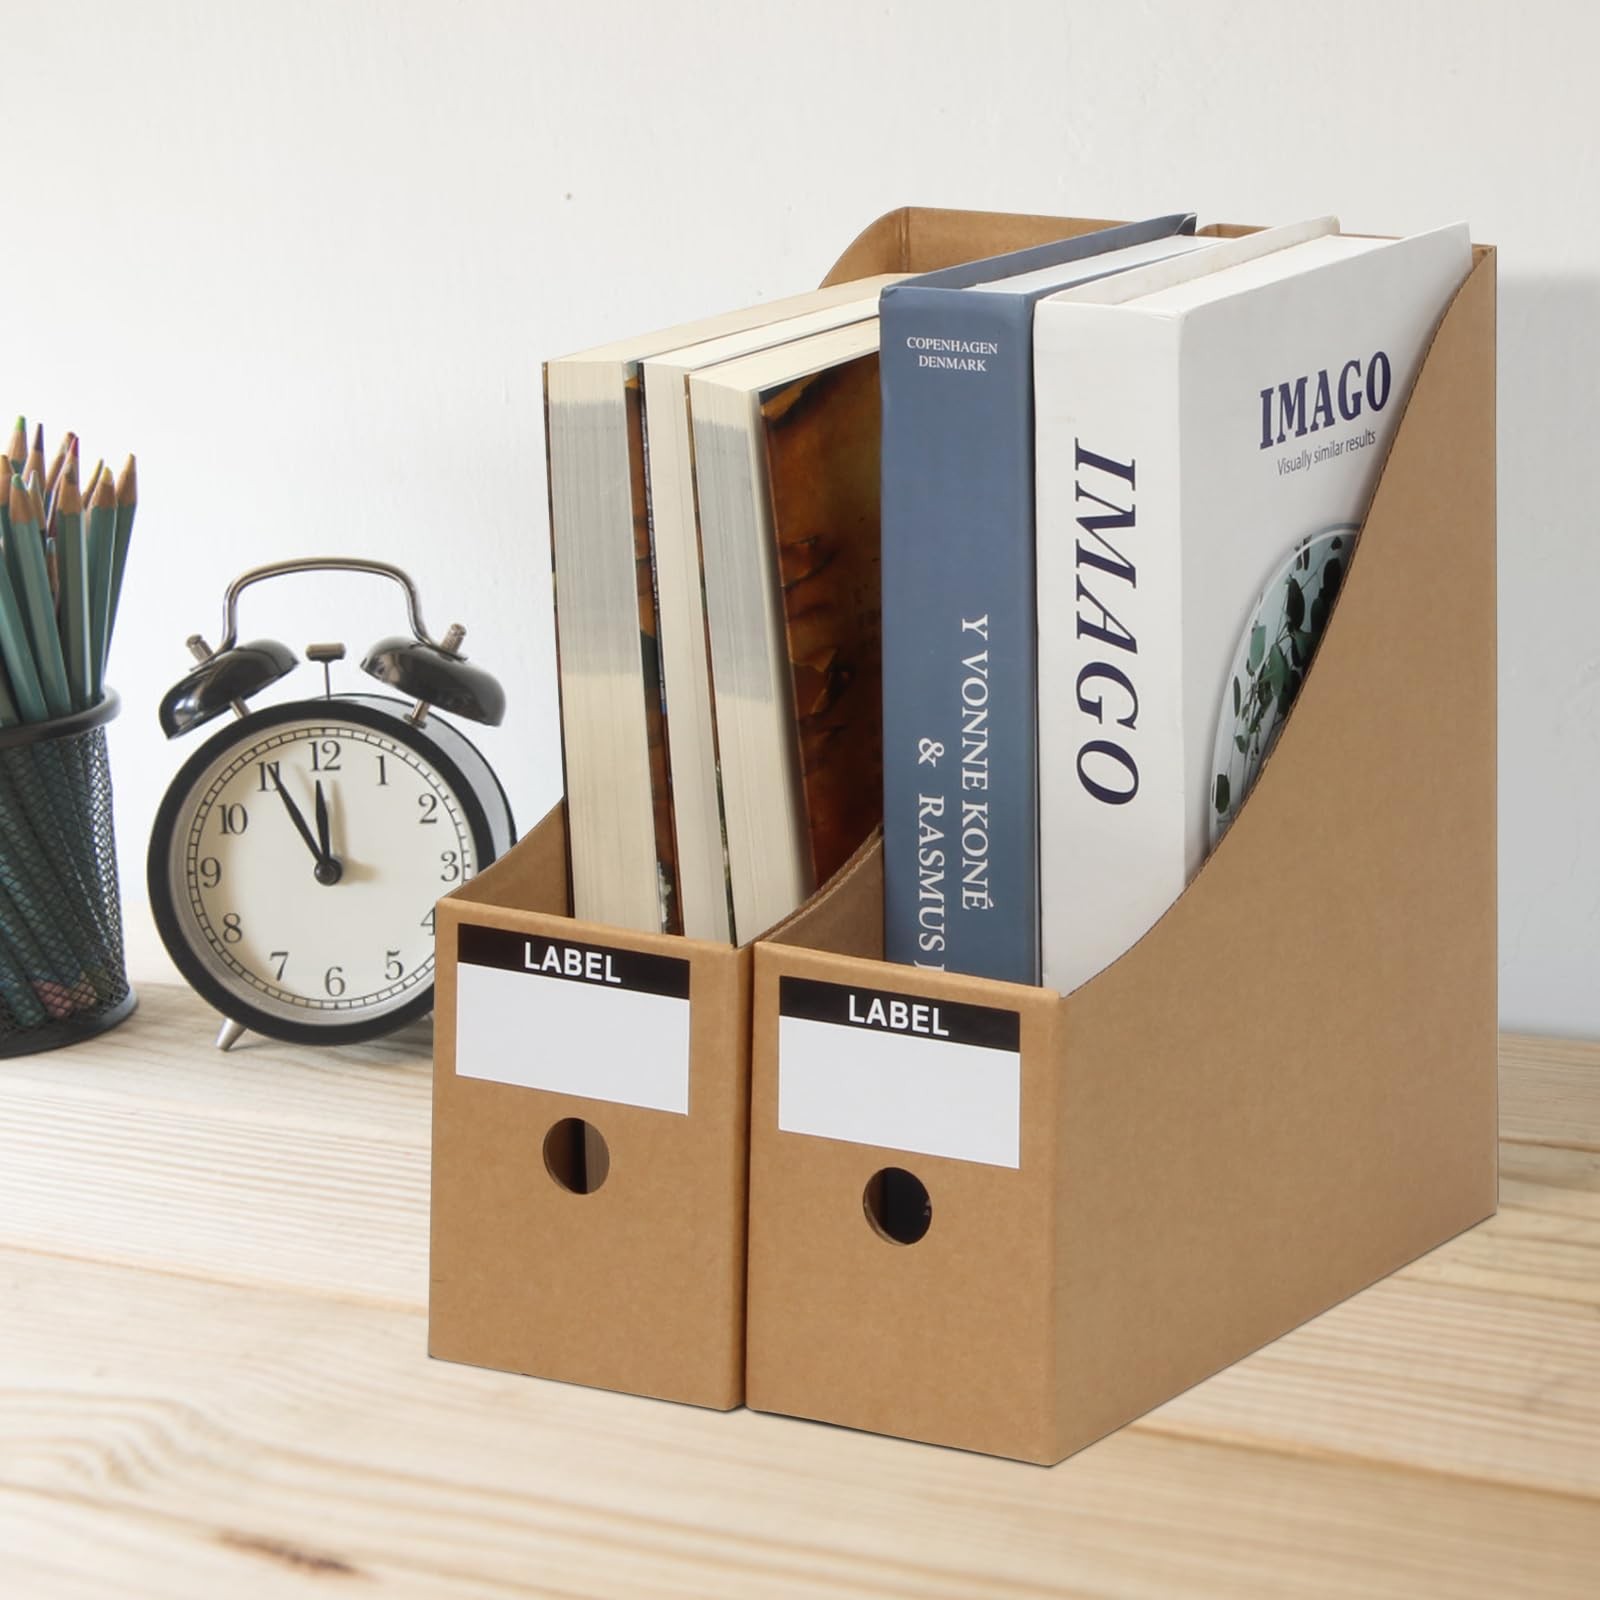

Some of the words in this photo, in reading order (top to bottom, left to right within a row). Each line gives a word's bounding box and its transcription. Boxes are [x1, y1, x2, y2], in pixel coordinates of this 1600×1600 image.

[906, 336, 998, 355] COPENHAGEN
[918, 355, 987, 372] DENMARK
[1260, 350, 1392, 450] IMAGO
[1277, 449, 1312, 476] Visually
[1313, 440, 1344, 464] similar
[1345, 428, 1377, 453] results
[1074, 437, 1140, 806] IMAGO
[309, 740, 342, 772] 12
[918, 736, 946, 768] &
[376, 755, 390, 786] 1
[218, 803, 249, 835] 10
[418, 793, 438, 825] 2
[440, 851, 460, 883] 3
[961, 799, 995, 911] KONÉ
[201, 857, 222, 888] 9
[918, 792, 946, 952] RASMUS
[223, 913, 242, 944] 8
[268, 951, 289, 981] 7
[384, 950, 405, 981] 5
[524, 941, 622, 984] LABEL
[324, 966, 346, 998] 6
[848, 994, 950, 1037] LABEL
